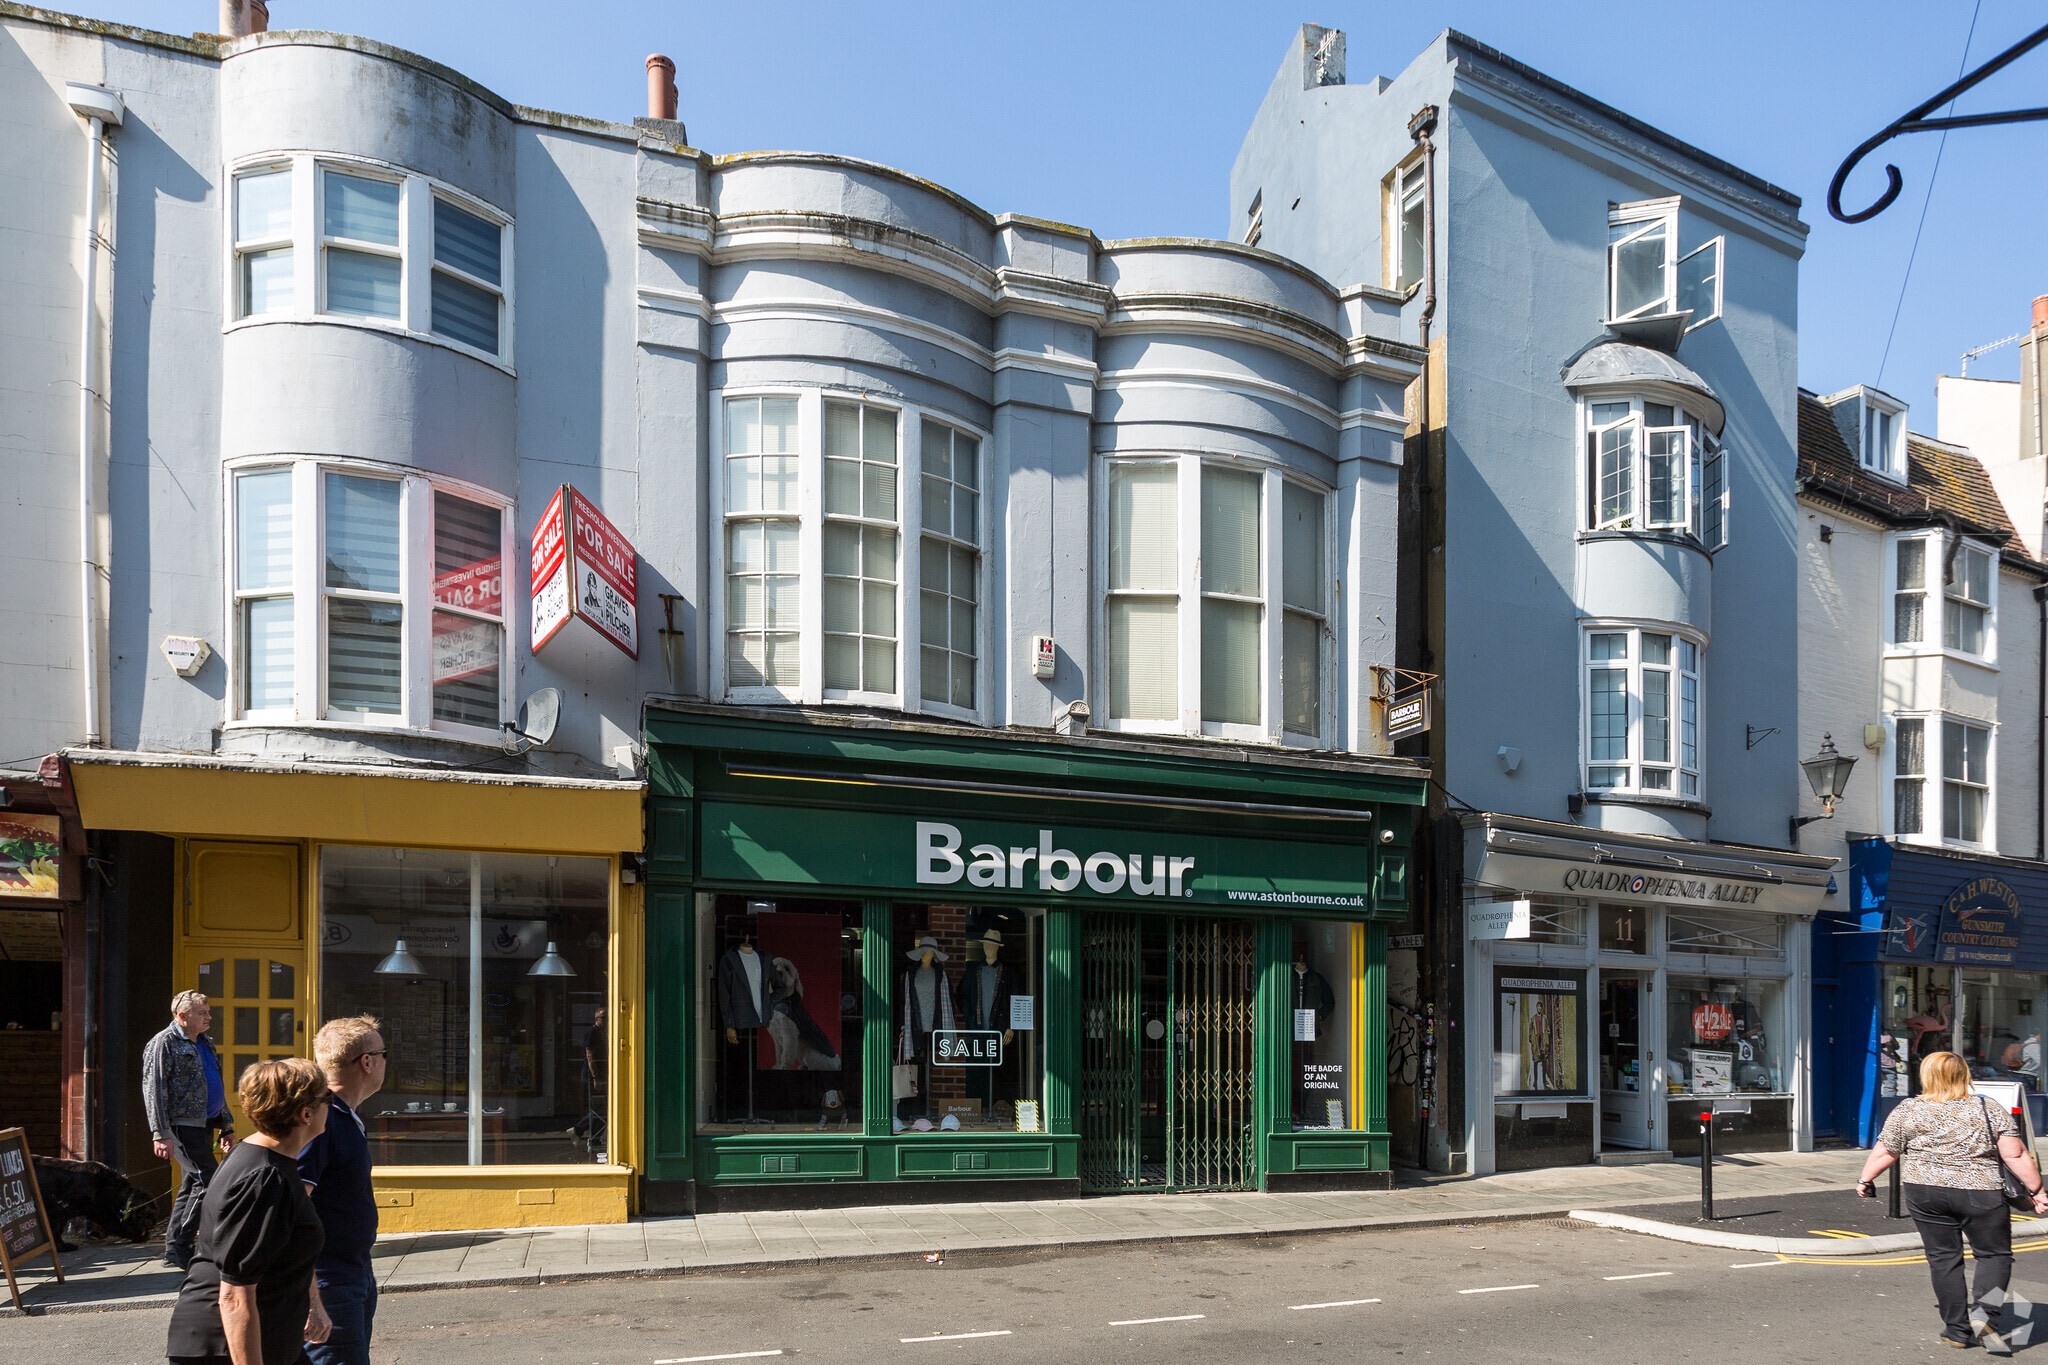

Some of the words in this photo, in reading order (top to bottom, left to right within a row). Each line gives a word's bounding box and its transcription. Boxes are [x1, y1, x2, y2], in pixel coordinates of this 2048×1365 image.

[575, 496, 605, 531] FREEHOLD
[605, 525, 634, 560] INVESTMENT
[532, 543, 544, 572] FOR
[544, 513, 562, 558] SALE
[576, 514, 604, 557] FOR
[607, 544, 635, 588] SALE
[604, 585, 630, 616] GRAVES
[605, 608, 632, 640] PILCHER
[1391, 702, 1420, 720] BARBOUR
[916, 821, 1194, 897] Barbour
[1563, 867, 1706, 900] QUADROPHENIA
[1707, 883, 1765, 904] ALLEY
[1227, 890, 1364, 907] www.astonbourne.co.uk
[1979, 877, 2022, 919] WESTON
[1470, 911, 1527, 922] QUADROPHENIA
[1487, 922, 1509, 930] ALLEY
[1615, 917, 1634, 942] 11
[1962, 919, 2005, 933] GUNSMITH
[1941, 932, 1981, 945] COUNTRY
[1981, 934, 2020, 948] CLOTHING
[1502, 978, 1554, 989] QUADROPHENIA
[1558, 981, 1575, 989] ALLEY
[938, 1039, 998, 1057] SALE
[1304, 1064, 1317, 1072] THE
[1318, 1064, 1343, 1072] BADGE
[1304, 1073, 1314, 1081] OF
[1315, 1073, 1327, 1081] AN
[1304, 1081, 1340, 1089] ORIGINAL
[0, 1148, 25, 1177] LUNCH
